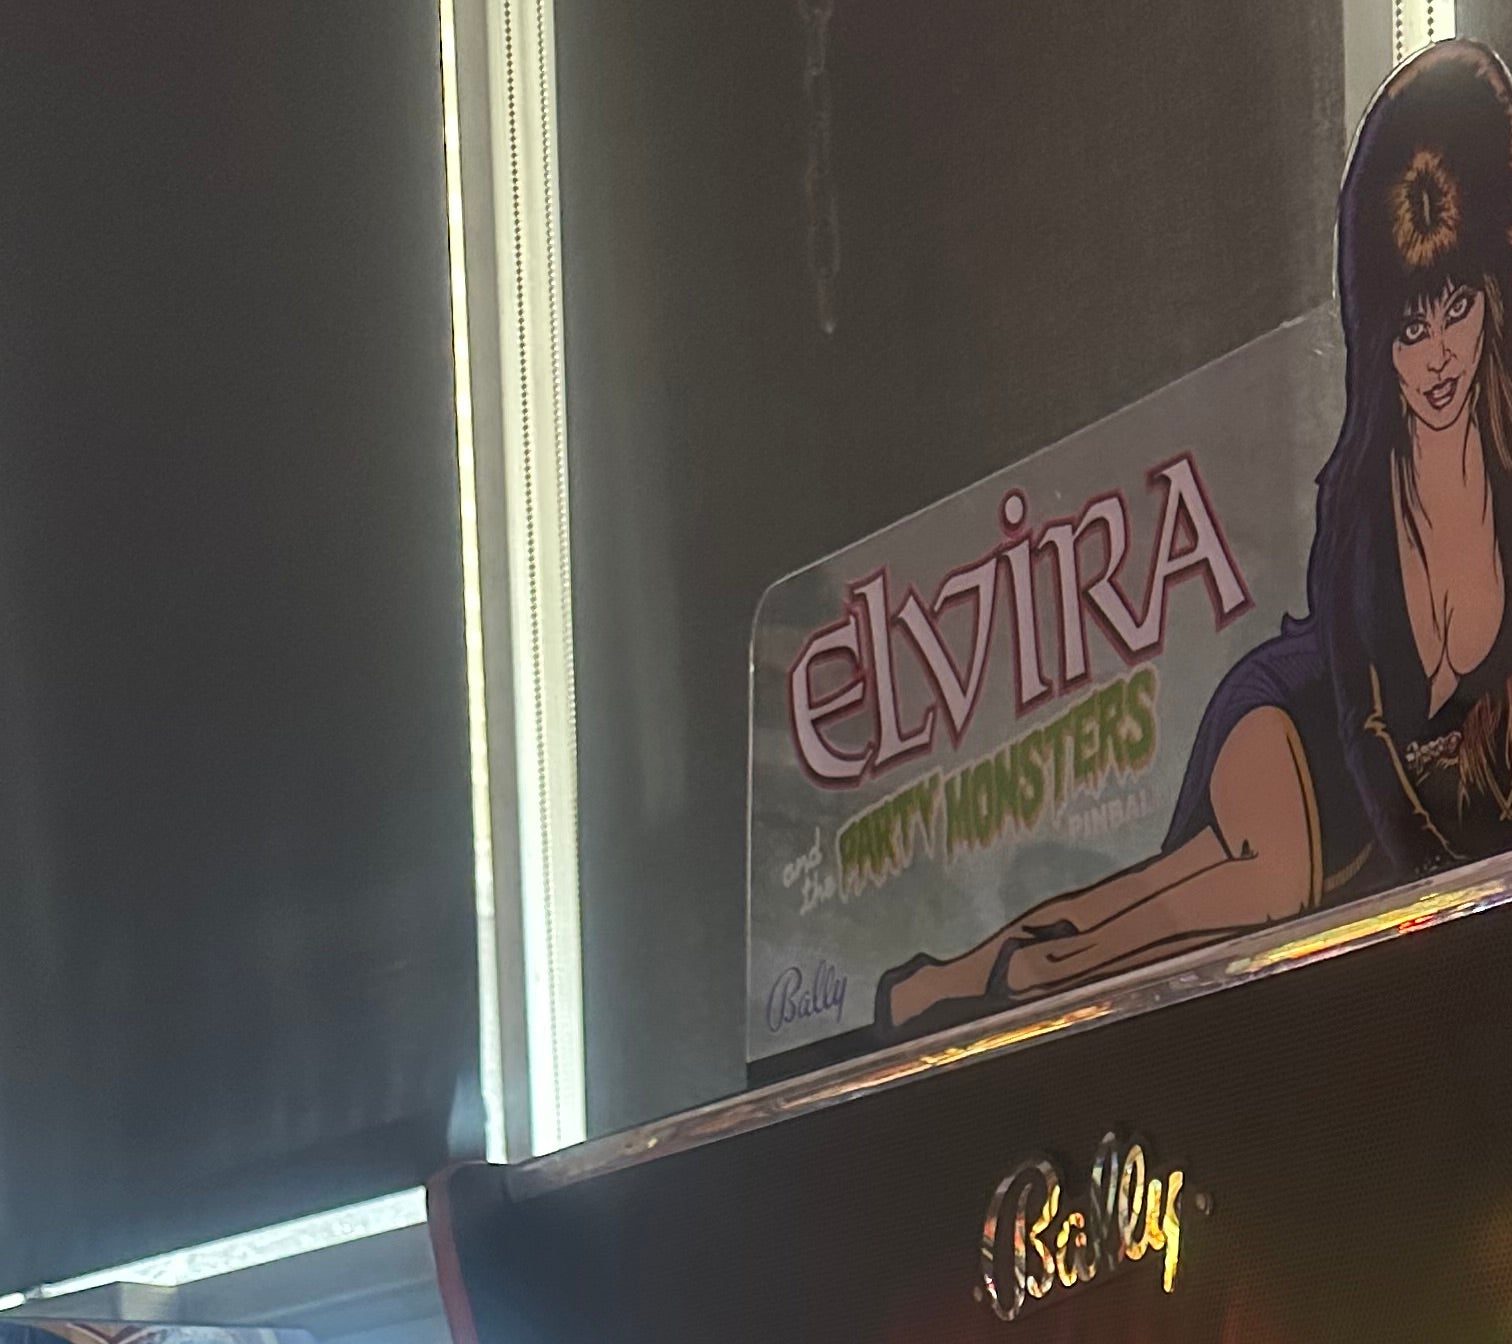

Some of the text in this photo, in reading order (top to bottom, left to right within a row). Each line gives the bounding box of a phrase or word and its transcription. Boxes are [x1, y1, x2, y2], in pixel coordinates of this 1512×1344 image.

[837, 661, 1159, 902] PARTY MONSTERS
[766, 960, 847, 1033] Bally
[981, 1131, 1184, 1322] Bally
